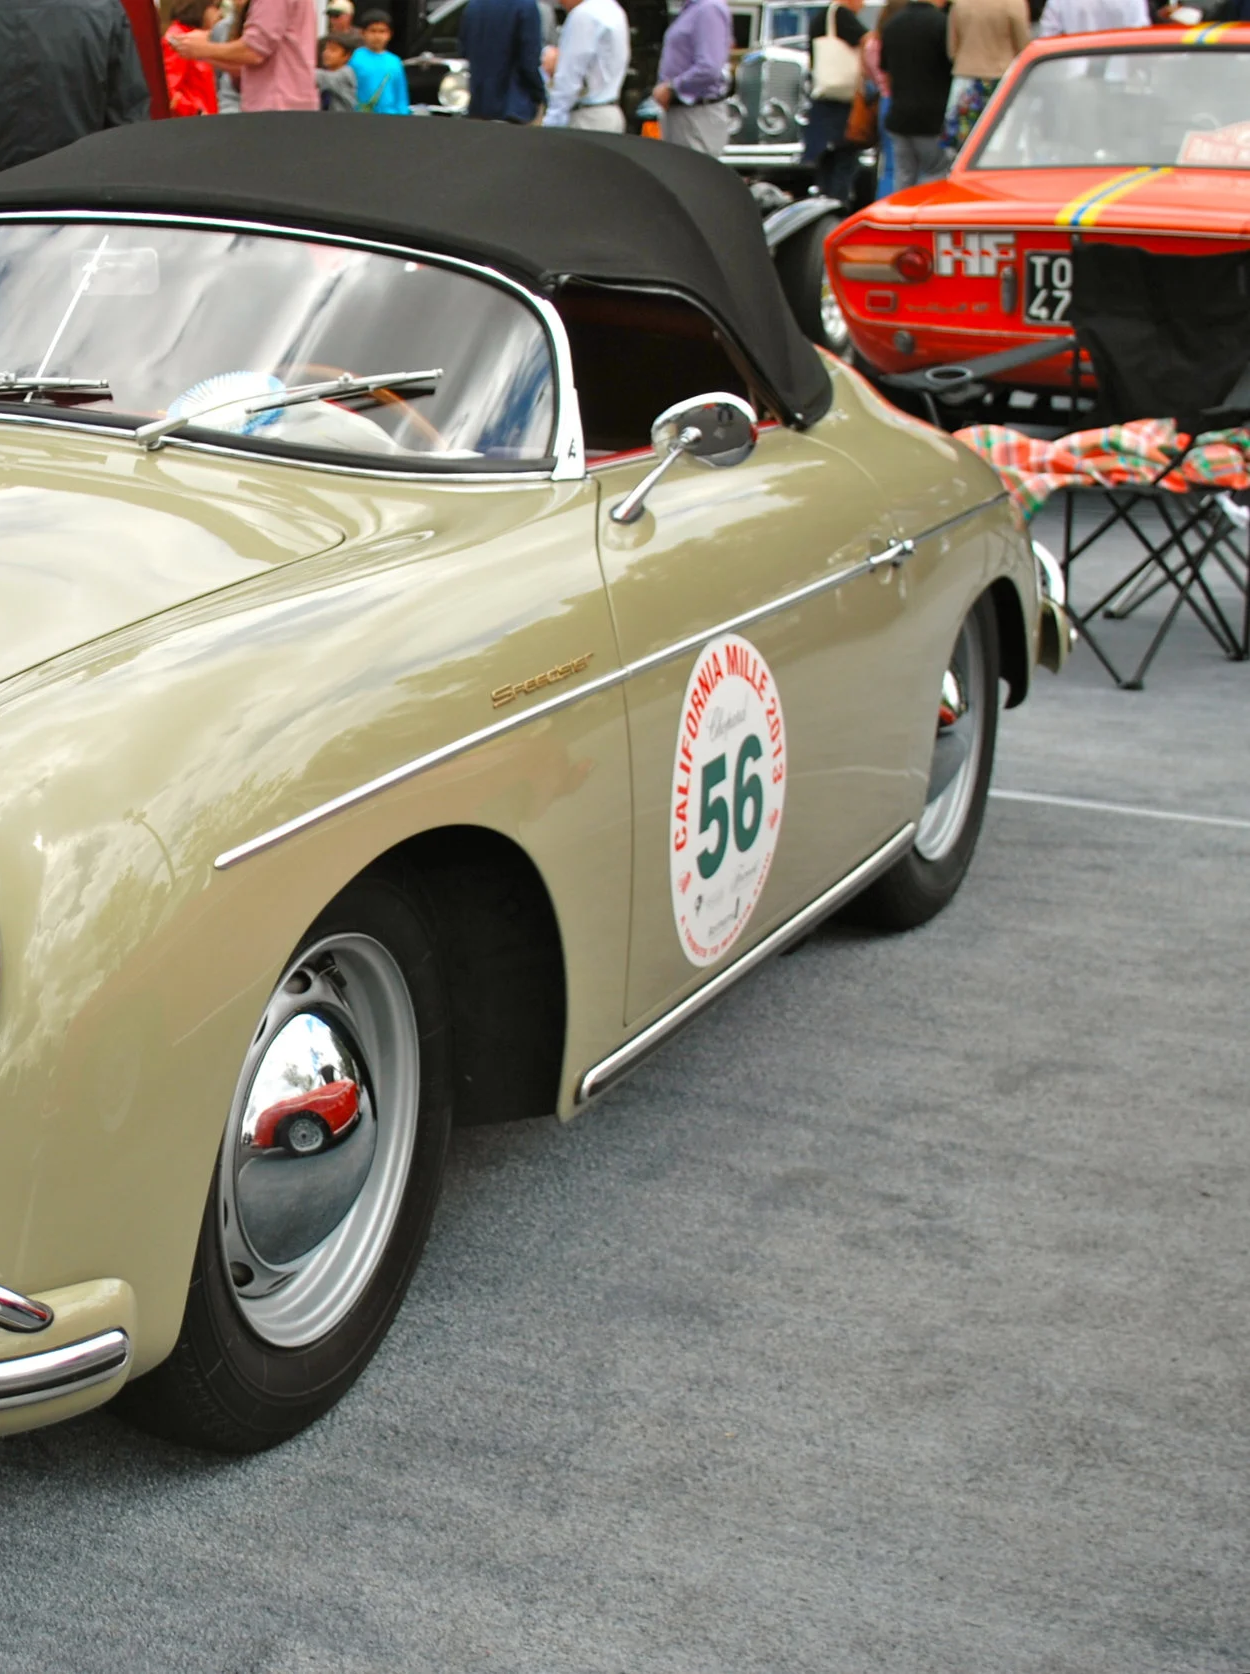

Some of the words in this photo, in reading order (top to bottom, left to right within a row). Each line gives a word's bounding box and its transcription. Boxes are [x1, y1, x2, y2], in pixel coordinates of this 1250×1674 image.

[934, 231, 1016, 277] HF
[1029, 255, 1073, 289] TO
[1028, 289, 1073, 322] 47
[674, 652, 724, 852] CALIFORNIA
[725, 644, 768, 703] MILLE
[765, 697, 784, 784] 2013
[696, 733, 763, 880] 56
